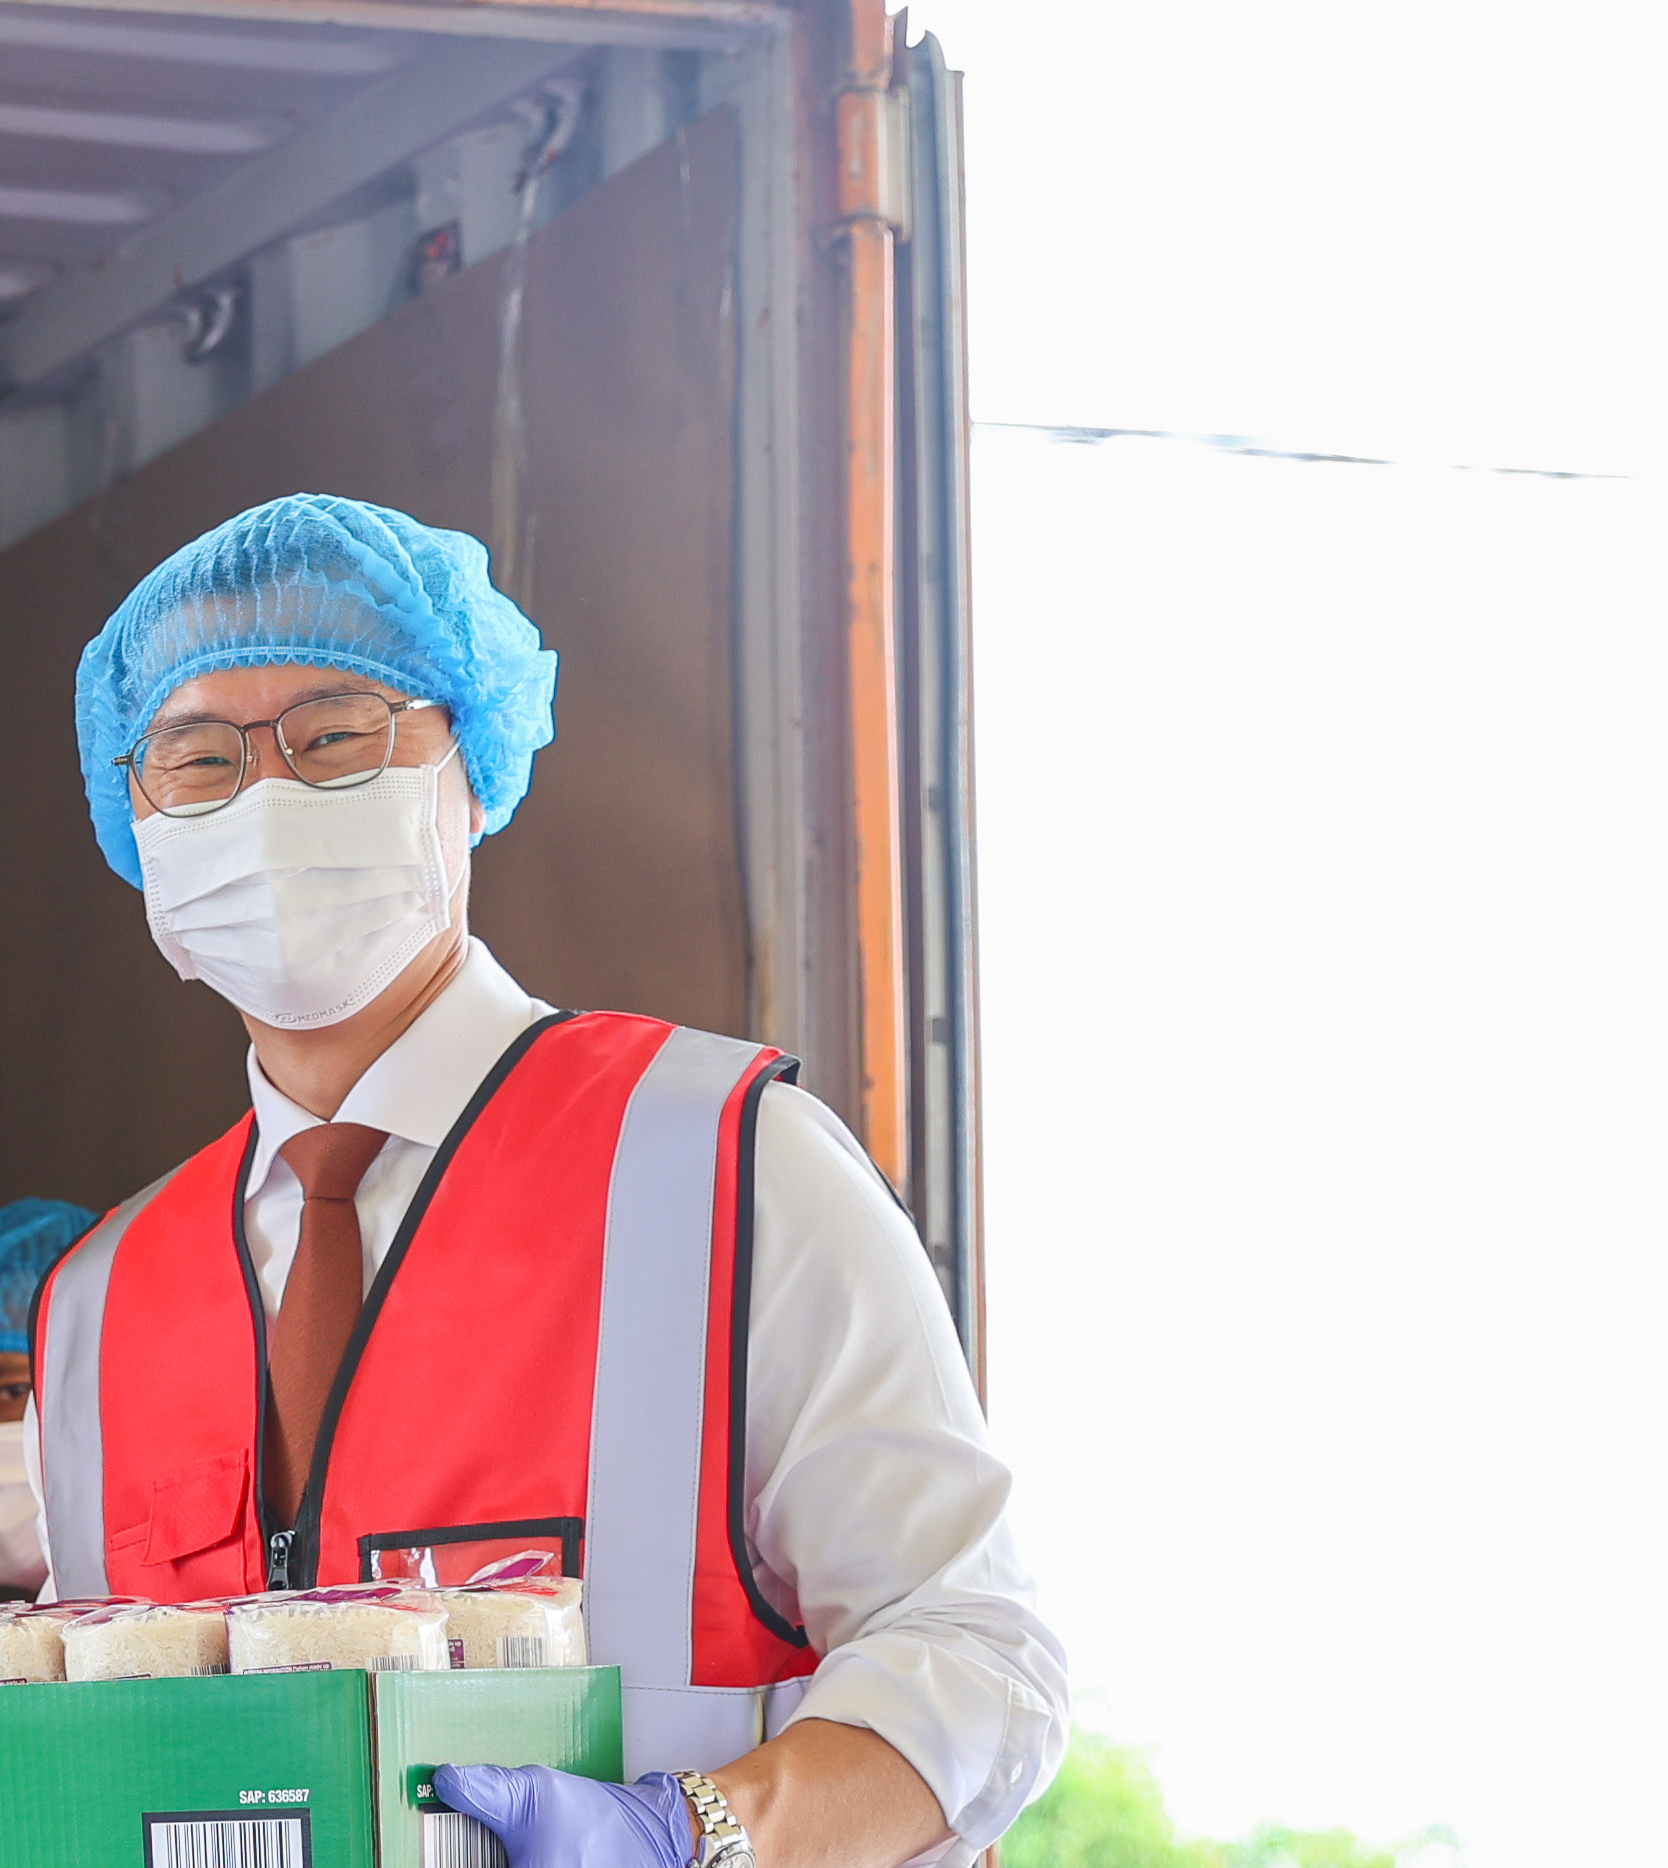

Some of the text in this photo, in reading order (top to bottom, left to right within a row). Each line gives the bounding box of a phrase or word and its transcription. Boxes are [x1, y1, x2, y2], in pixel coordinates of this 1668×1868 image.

[239, 1788, 311, 1804] SAP: 636587
[416, 1784, 434, 1798] SAP:
